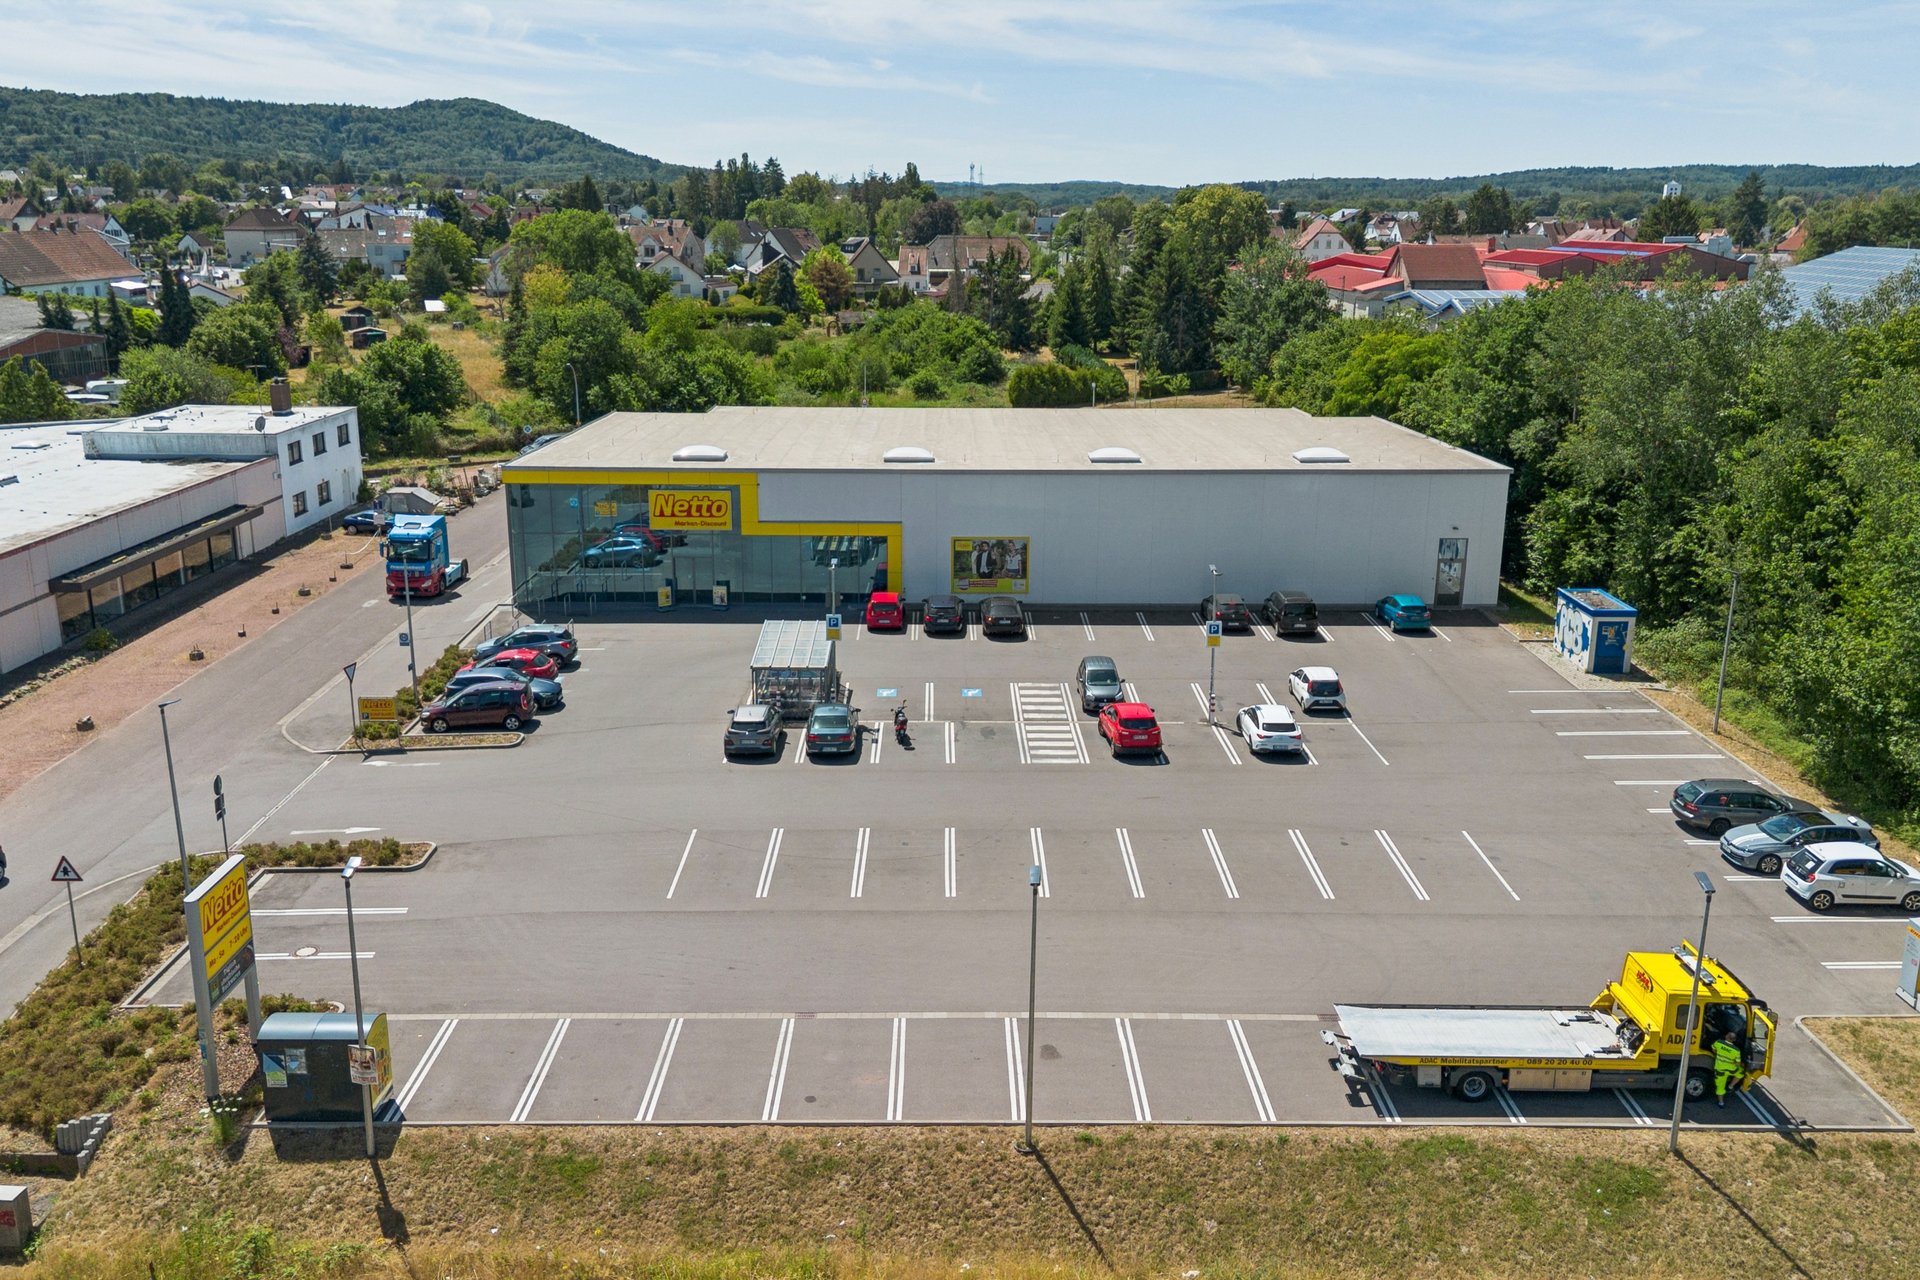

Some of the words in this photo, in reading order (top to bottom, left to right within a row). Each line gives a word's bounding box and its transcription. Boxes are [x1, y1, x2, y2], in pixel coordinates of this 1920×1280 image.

[653, 493, 728, 518] Netto
[830, 618, 838, 627] P
[1210, 625, 1218, 634] P
[362, 699, 393, 709] Netto
[202, 876, 245, 935] Netto
